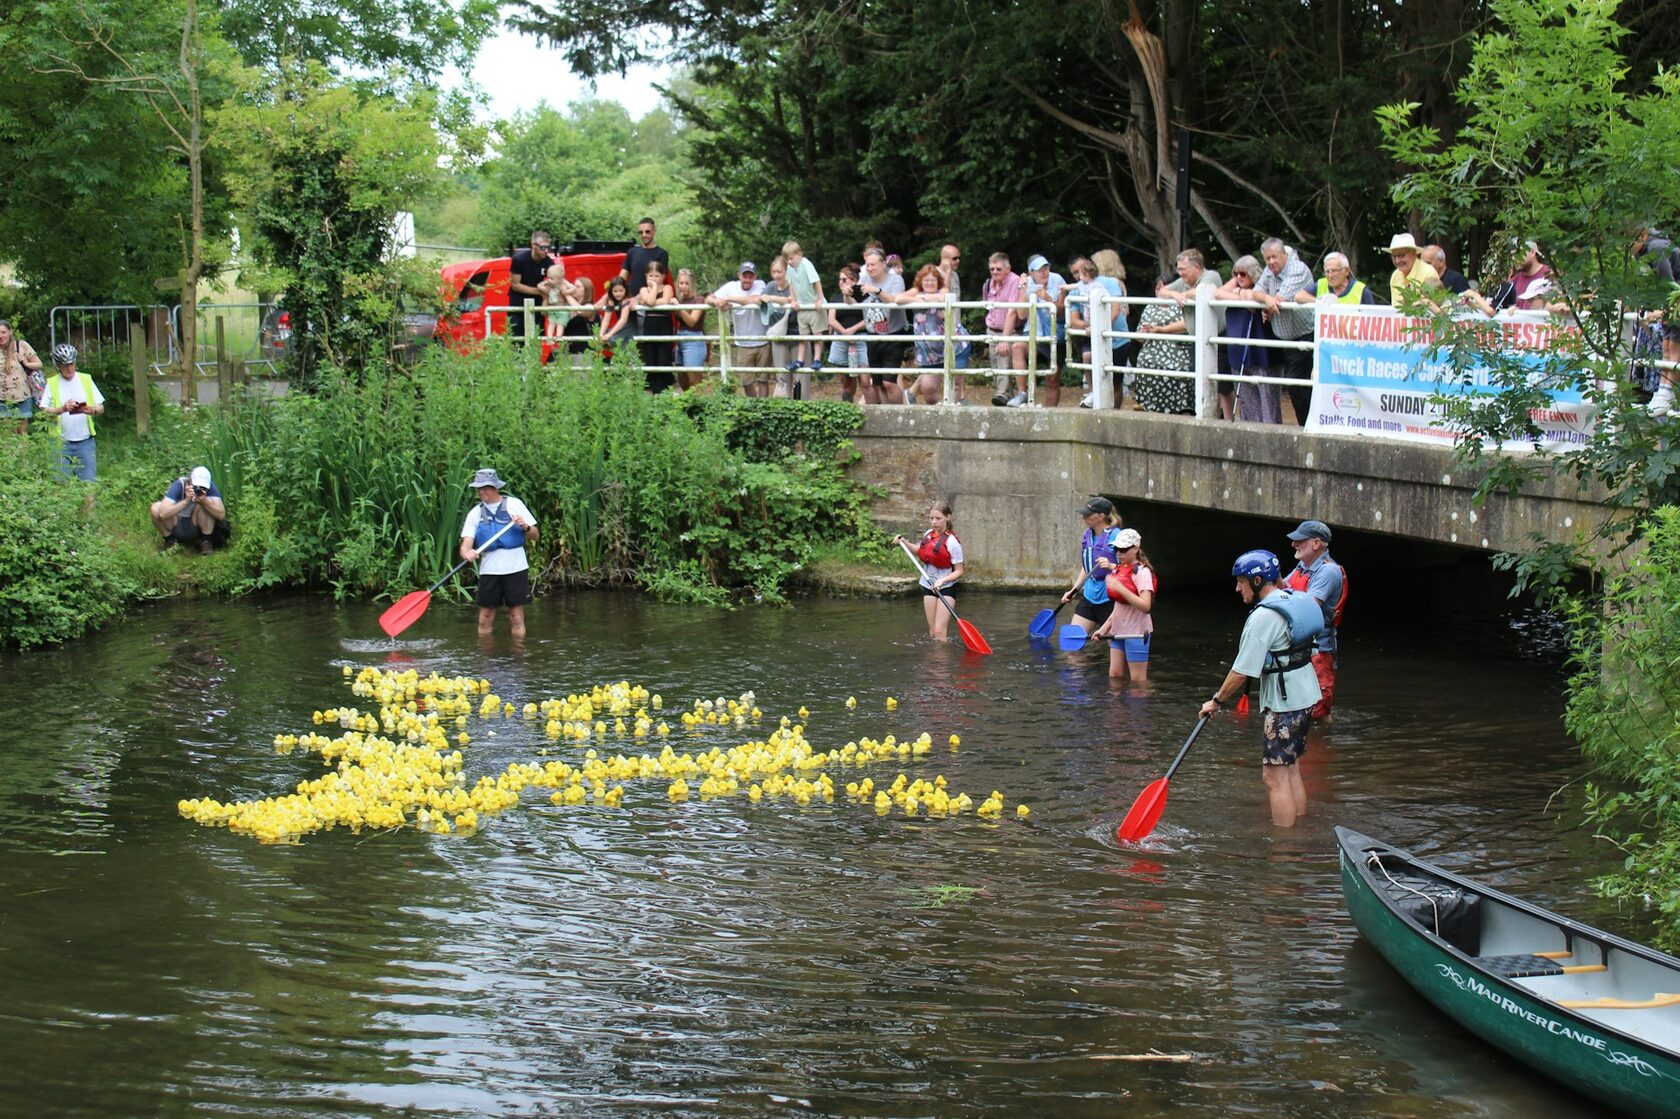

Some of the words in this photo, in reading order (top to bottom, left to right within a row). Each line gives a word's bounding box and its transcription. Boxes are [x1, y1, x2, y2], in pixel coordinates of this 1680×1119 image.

[1319, 314, 1408, 343] FAKENHAM
[1503, 322, 1585, 353] FESTI
[1330, 354, 1364, 377] Duck
[1366, 357, 1408, 380] Races
[1380, 393, 1426, 415] SUNDAY
[1347, 415, 1366, 428] Food
[1367, 417, 1382, 430] and
[1383, 420, 1402, 432] more
[1527, 407, 1548, 422] FREE
[1549, 410, 1579, 423] ENTRY
[1546, 430, 1567, 443] Mill
